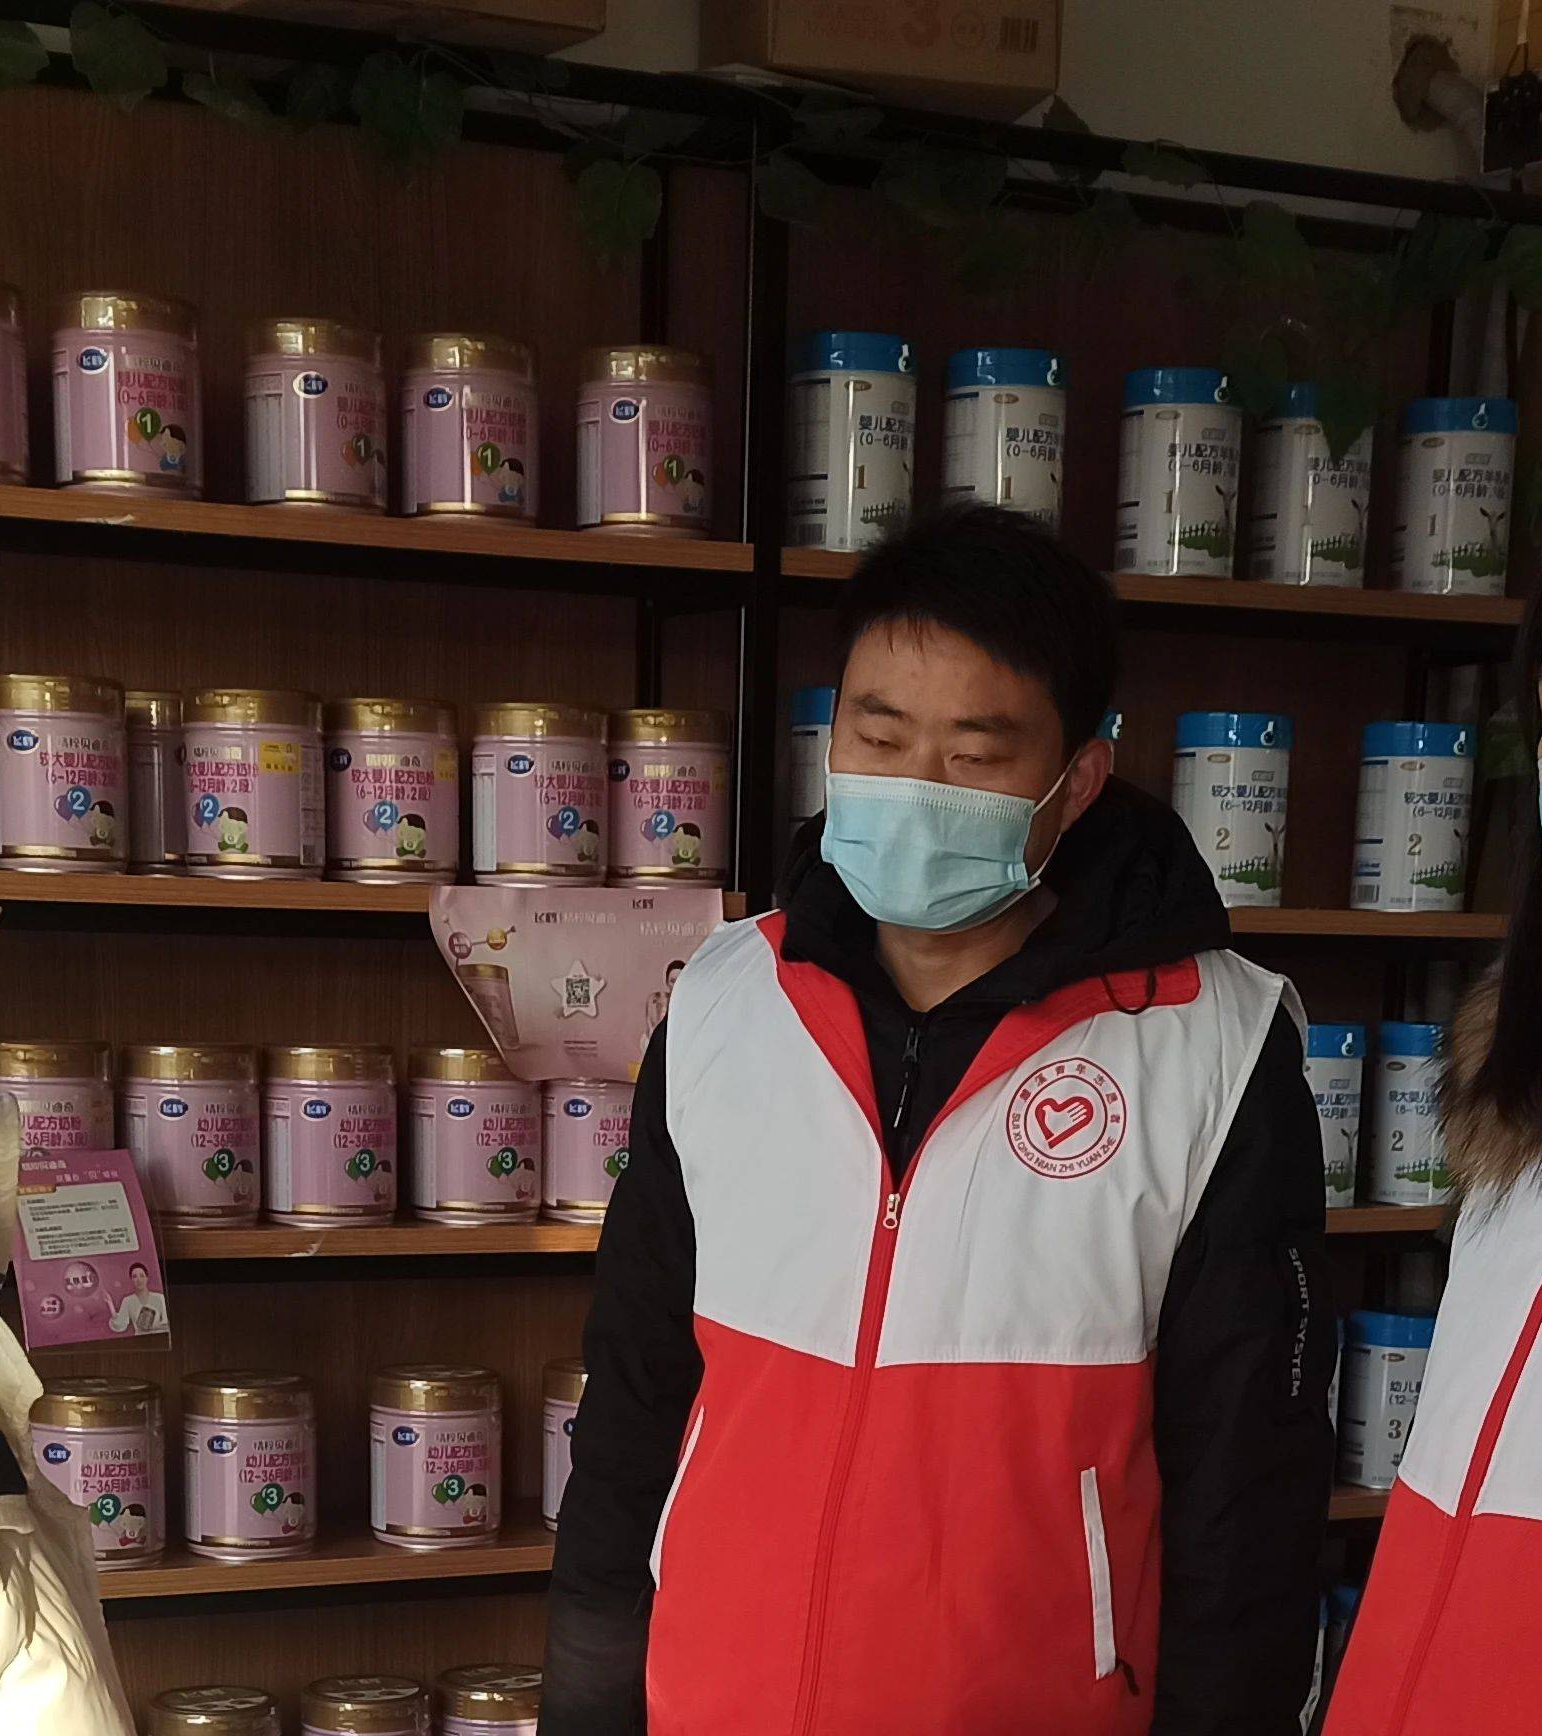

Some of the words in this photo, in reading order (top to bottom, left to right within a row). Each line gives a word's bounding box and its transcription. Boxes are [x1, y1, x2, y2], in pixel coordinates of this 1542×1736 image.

[71, 791, 86, 811] 2
[202, 799, 215, 818] 2
[378, 805, 392, 825] 2
[562, 811, 575, 831] 2
[655, 814, 669, 834] 2
[1287, 1247, 1310, 1312] SPORT
[1290, 1316, 1309, 1397] SYSTEM
[265, 1485, 279, 1504] 3
[447, 1478, 460, 1496] 3
[100, 1497, 115, 1517] 3
